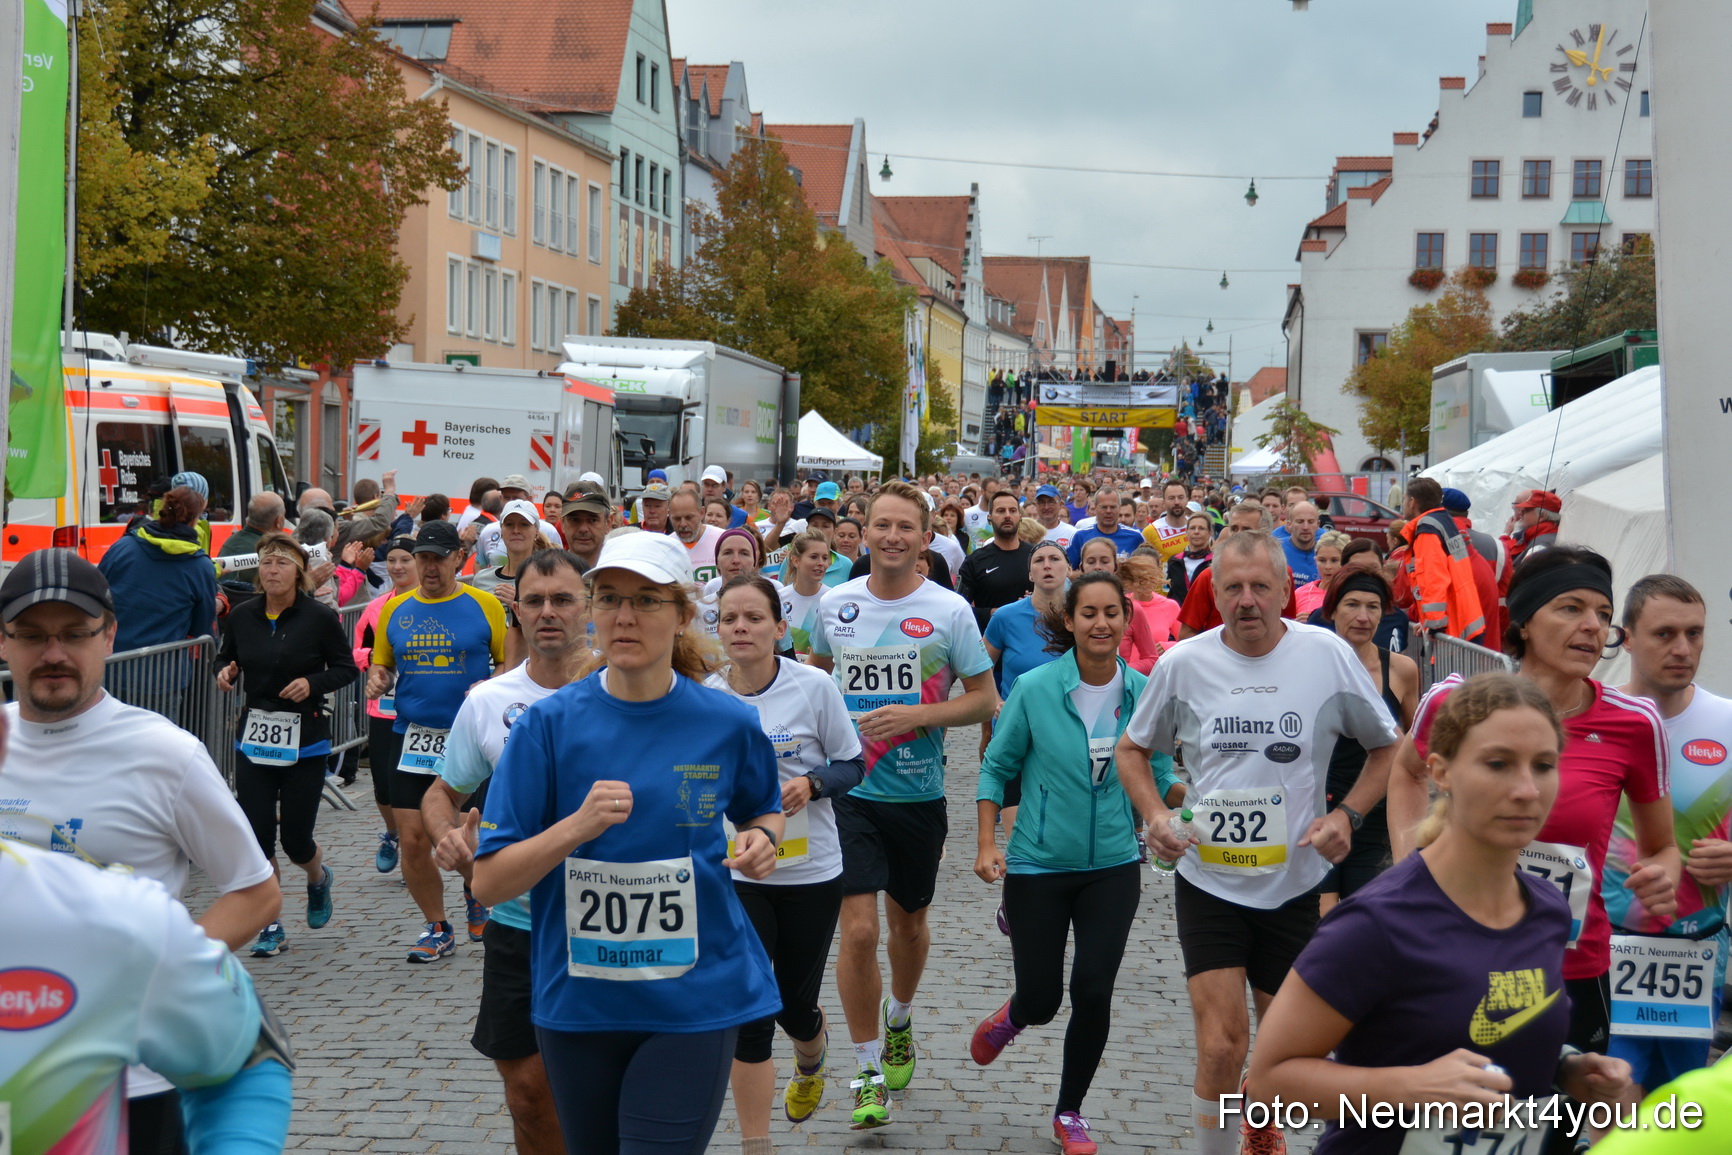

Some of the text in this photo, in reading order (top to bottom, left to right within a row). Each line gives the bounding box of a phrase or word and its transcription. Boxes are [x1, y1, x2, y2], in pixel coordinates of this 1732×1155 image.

[1080, 412, 1128, 423] START
[445, 422, 511, 434] Bayerisches
[444, 436, 475, 446] Rotes
[118, 450, 152, 468] Bayerisches
[443, 450, 475, 460] Kreuz
[802, 456, 846, 466] Laufsport
[1162, 538, 1182, 549] MAX
[834, 626, 856, 634] PARTL
[904, 621, 930, 633] Hervis
[842, 652, 905, 661] PARTL Neumarkt
[847, 663, 914, 691] 2616
[262, 715, 291, 723] Neumarkt
[1212, 716, 1275, 735] Allianz
[248, 721, 293, 746] 2381
[253, 747, 282, 758] Claudia
[1090, 745, 1115, 753] eumar
[1687, 744, 1722, 759] Hervis
[1090, 757, 1111, 782] 7
[0, 798, 31, 807] markter
[1222, 797, 1268, 807] Neumarkt
[1210, 811, 1268, 843] 232
[52, 842, 75, 852] DKMS
[1222, 851, 1258, 867] Georg
[569, 869, 671, 886] PARTL Neumarkt
[580, 889, 684, 935] 2075
[597, 945, 664, 967] Dagmar
[1609, 944, 1698, 959] PARTL Neumarkt
[1614, 960, 1704, 1000] 2455
[0, 984, 64, 1015] ervis
[1636, 1006, 1679, 1023] Albert
